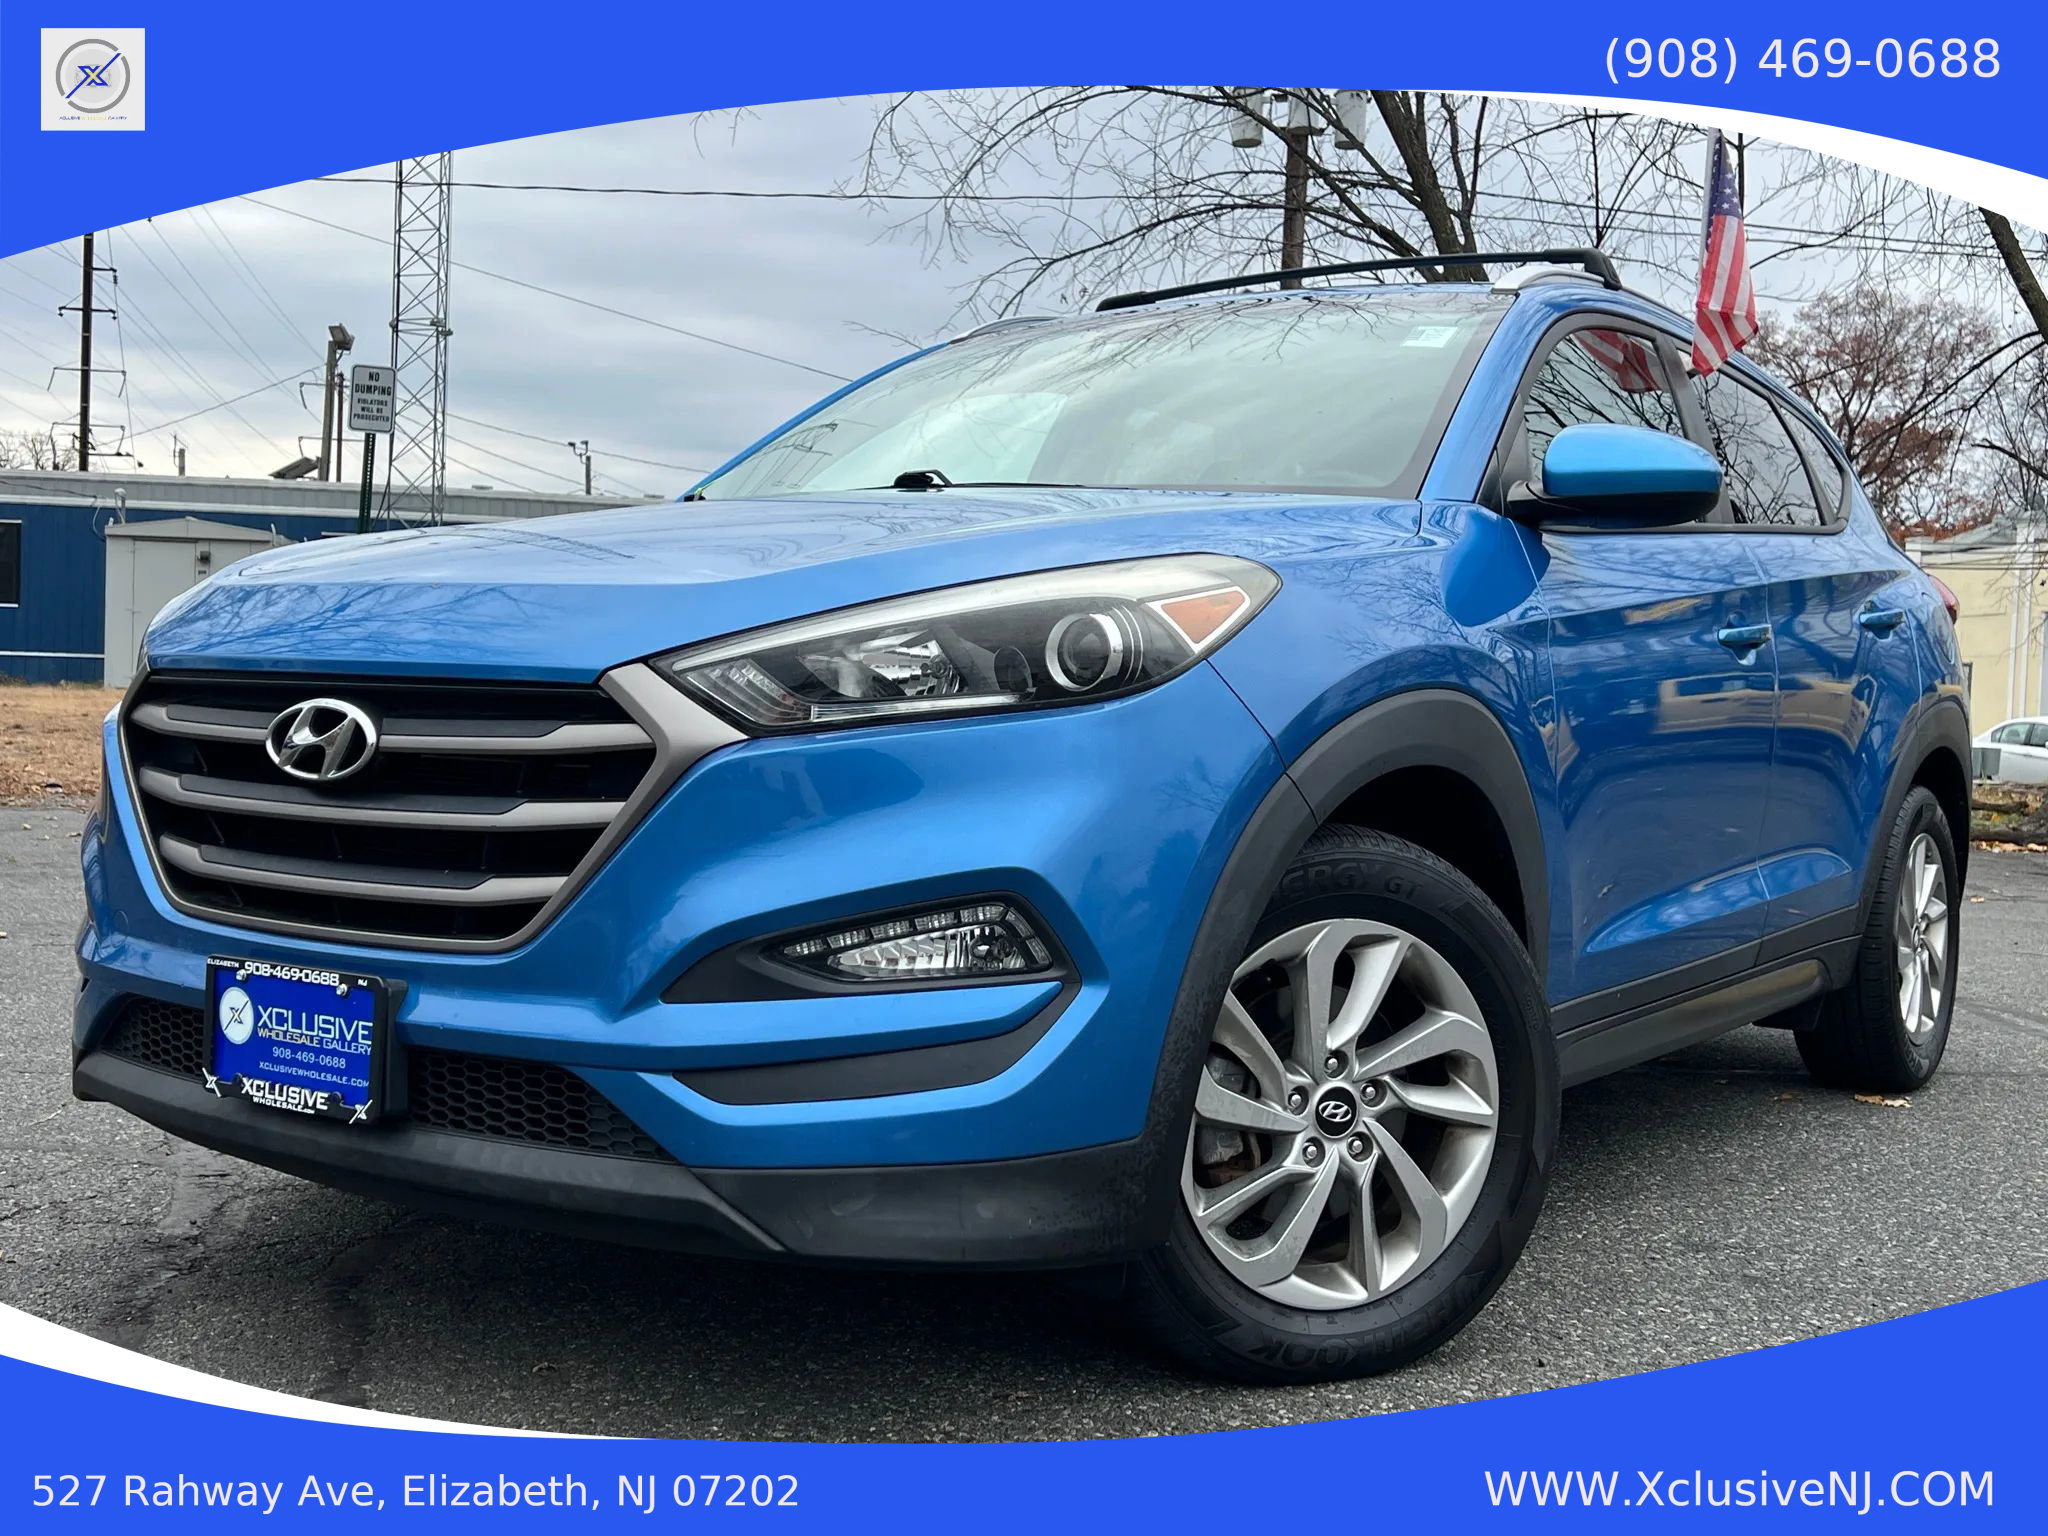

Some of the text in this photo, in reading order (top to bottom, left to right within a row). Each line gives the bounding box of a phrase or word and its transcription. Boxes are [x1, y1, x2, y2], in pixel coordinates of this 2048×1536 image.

[369, 371, 380, 382] NO
[355, 384, 392, 396] DUMPING
[358, 398, 388, 406] VIOLATORS
[353, 413, 390, 422] PROSECUTED
[207, 958, 239, 968] ELIZABETH
[357, 978, 368, 986] NJ
[257, 1005, 374, 1045] XCLUSIVE
[257, 1028, 372, 1056] WHOLESALE GALLERY
[272, 1046, 346, 1069] 908-469-0688
[259, 1061, 370, 1087] XCLUSIVEWHOLESALE.COM
[241, 1077, 329, 1111] XCLUSIVE
